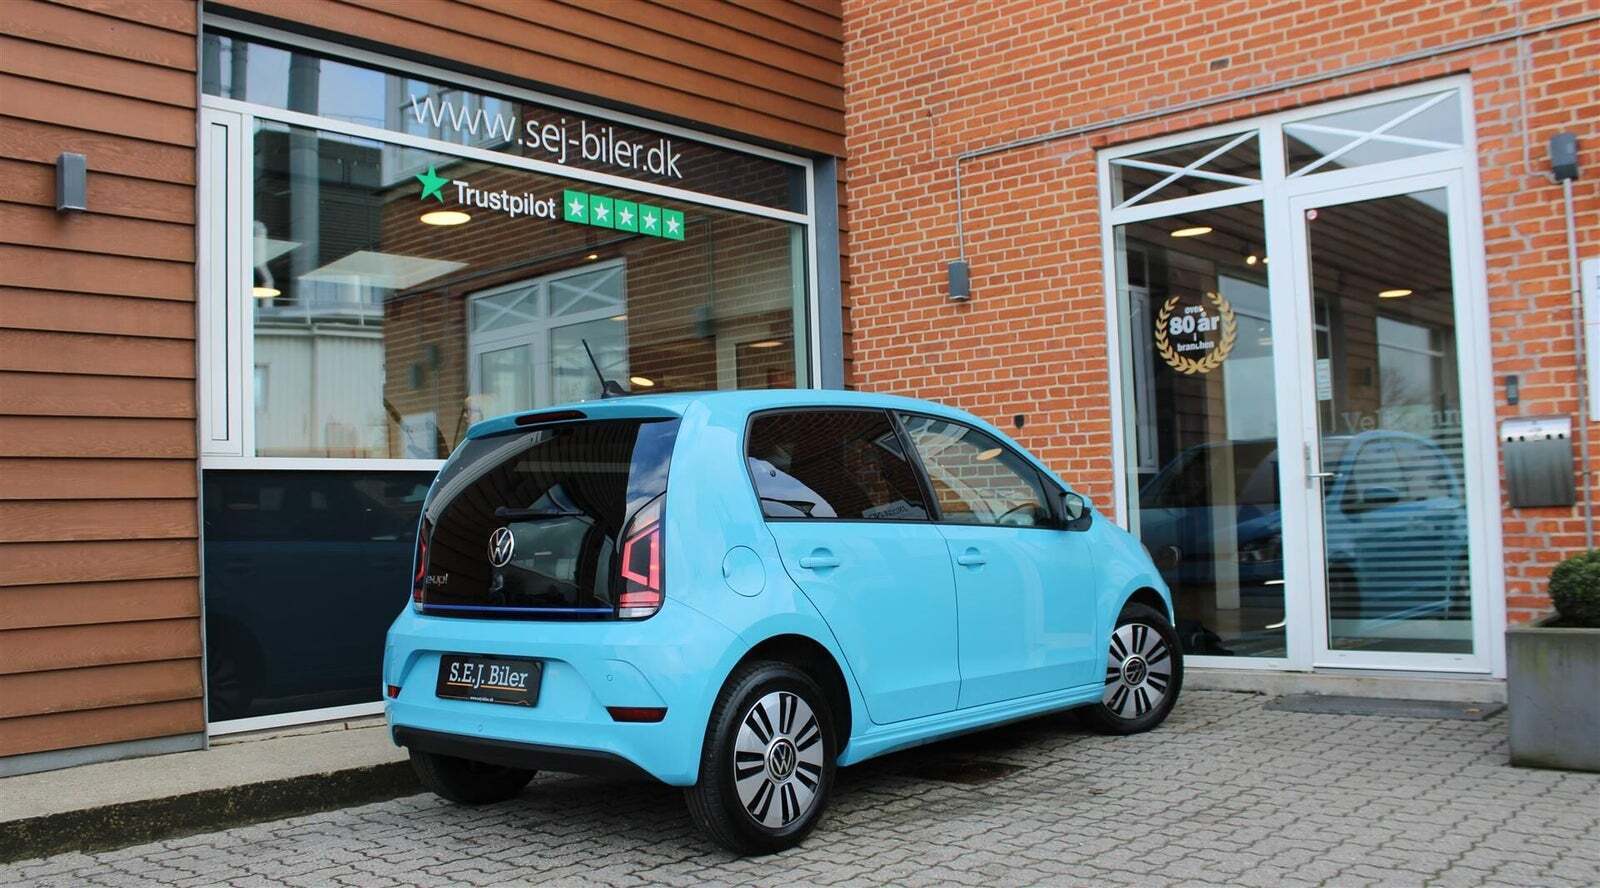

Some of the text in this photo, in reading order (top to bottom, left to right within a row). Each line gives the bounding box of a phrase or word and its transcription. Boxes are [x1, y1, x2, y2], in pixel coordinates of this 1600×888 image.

[411, 94, 683, 179] www.sej-biler.dk
[453, 179, 557, 220] Trustpilot
[1169, 311, 1220, 335] 80 år
[449, 662, 528, 689] S.E.J. Biler
